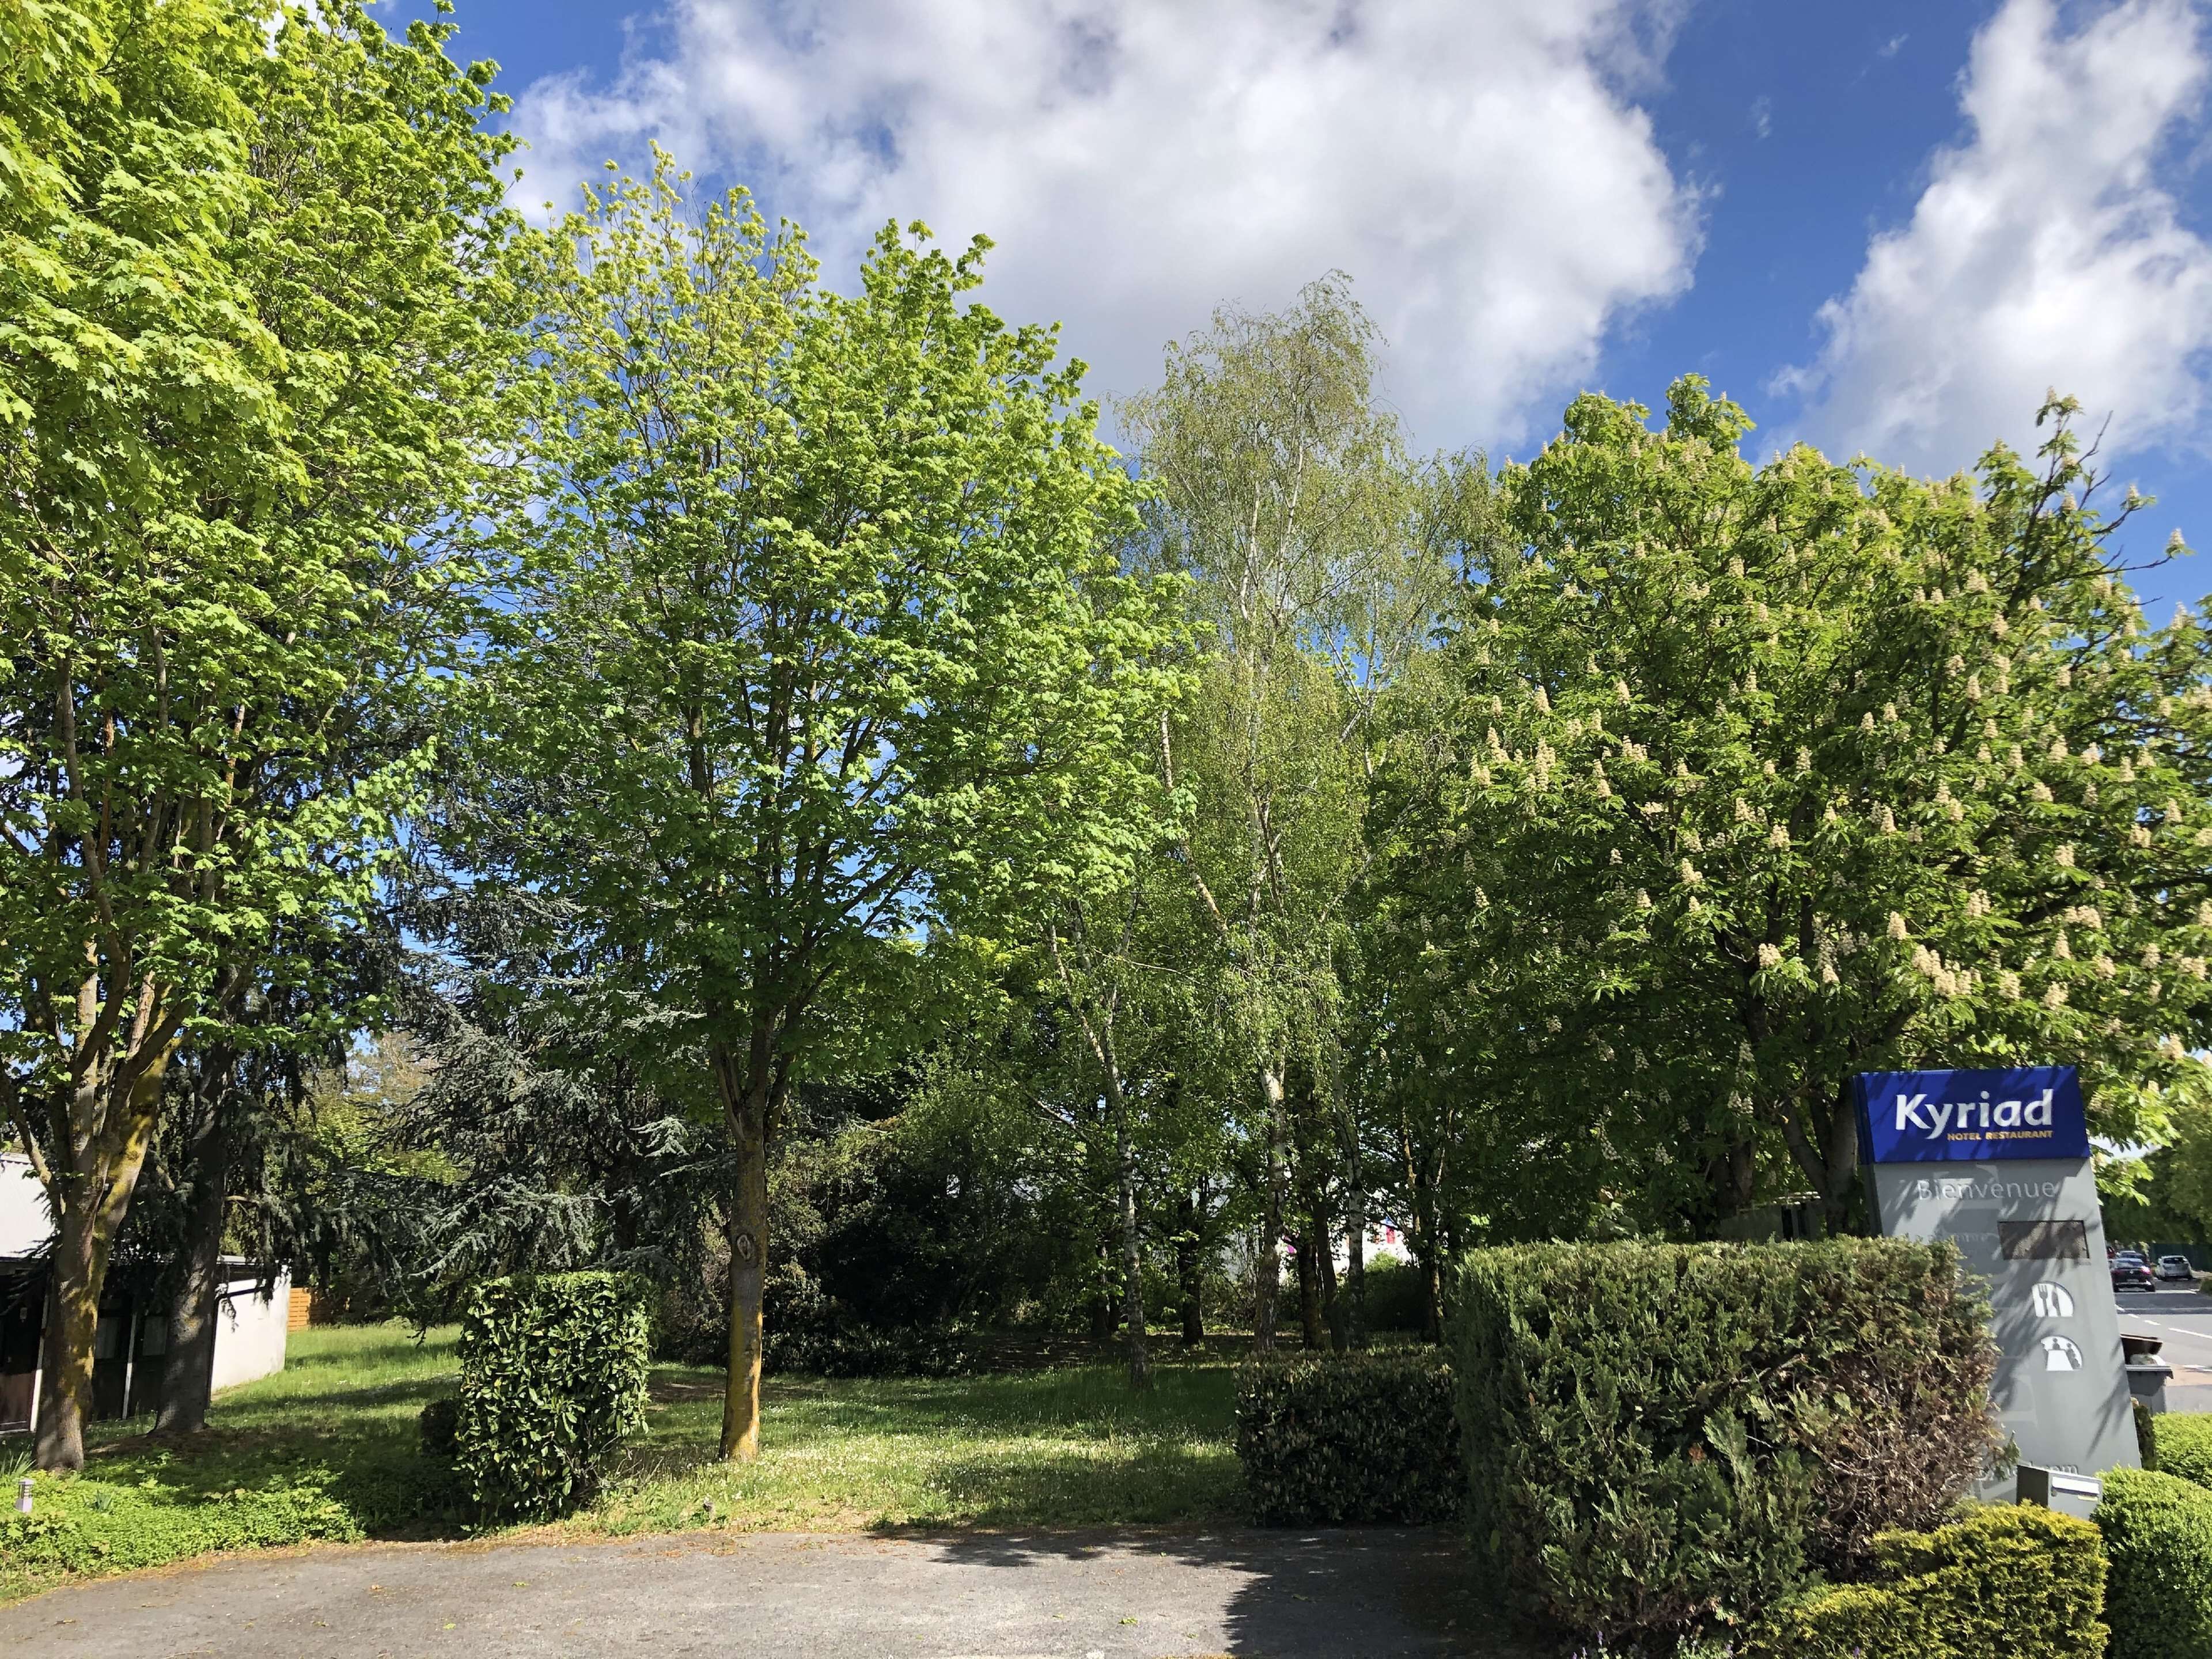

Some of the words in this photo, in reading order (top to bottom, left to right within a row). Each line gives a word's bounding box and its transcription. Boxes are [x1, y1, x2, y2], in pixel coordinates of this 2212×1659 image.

[1895, 1088, 2054, 1140] Kyriad
[1947, 1132, 1982, 1141] HOTEL
[1985, 1130, 2053, 1140] RESTAURANT
[1917, 1179, 2055, 1200] Bienvenue
